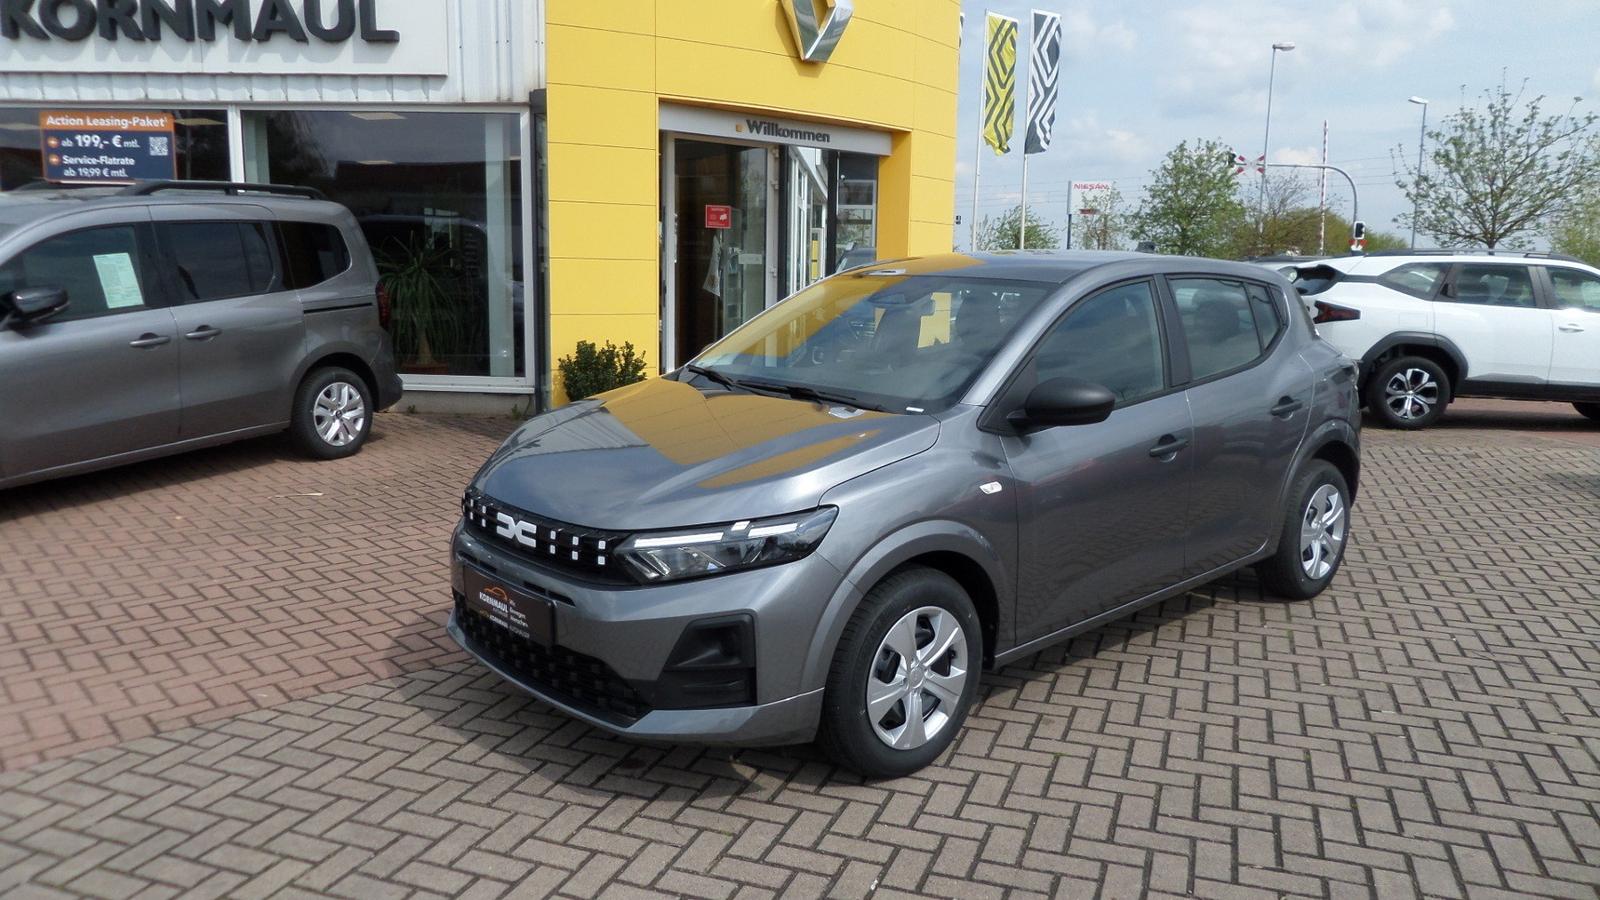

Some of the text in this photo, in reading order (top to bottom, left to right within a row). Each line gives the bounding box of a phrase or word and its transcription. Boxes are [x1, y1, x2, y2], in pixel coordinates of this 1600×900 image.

[1, 0, 400, 44] KORNMAUL
[46, 115, 84, 126] Action
[746, 119, 831, 143] Willkommen
[61, 138, 73, 147] ab
[112, 135, 123, 148] €
[62, 155, 135, 165] Service-Flatrate
[64, 167, 76, 177] ab
[78, 167, 101, 178] 19,99
[102, 168, 110, 177] €
[479, 591, 509, 613] KORNMAUL
